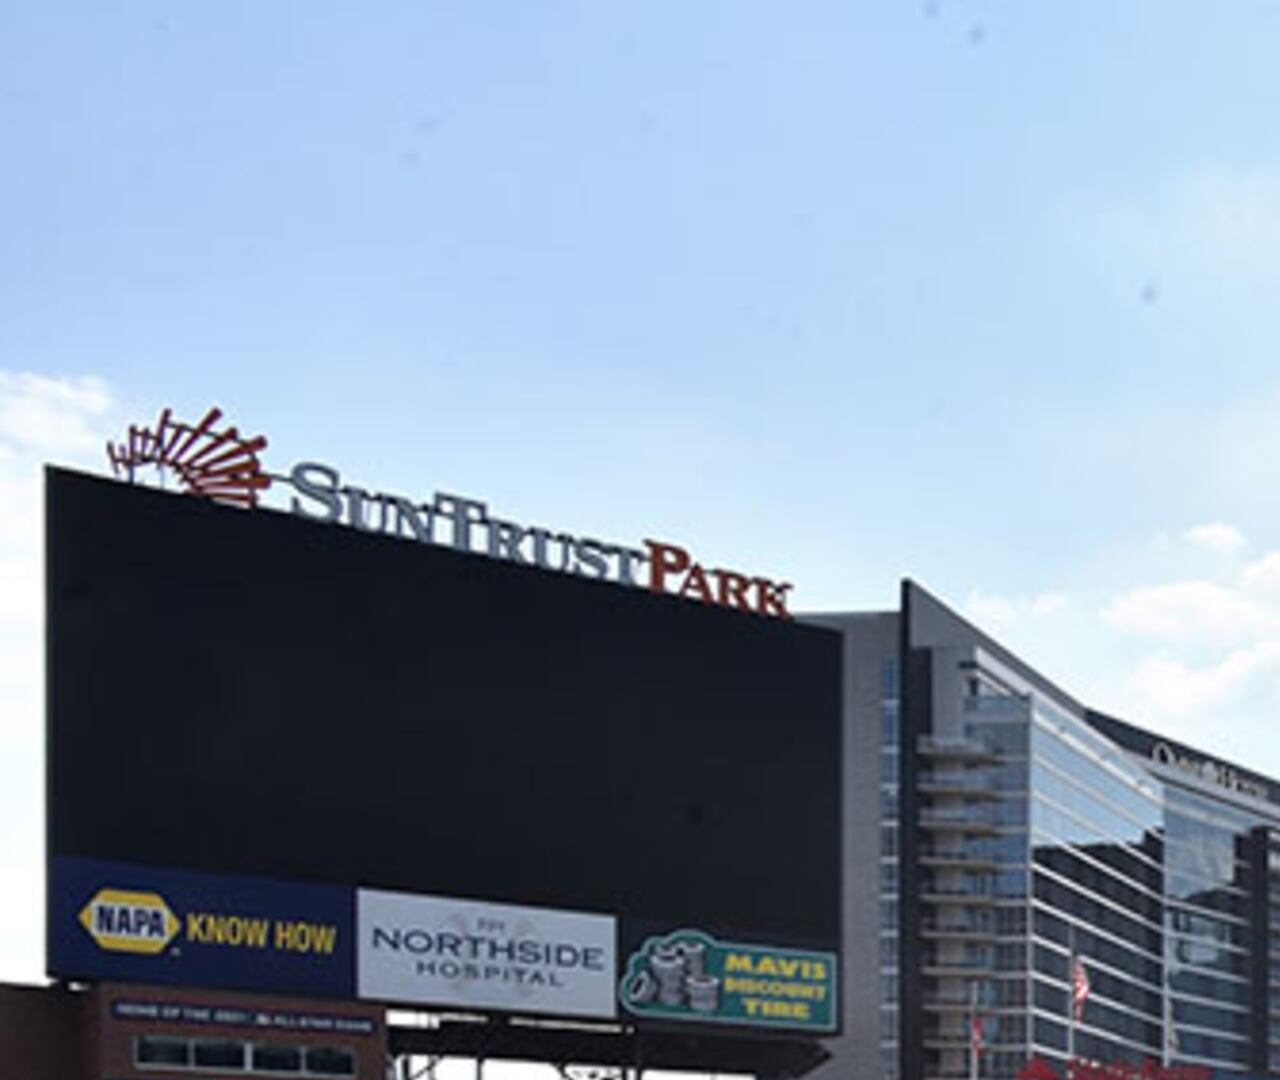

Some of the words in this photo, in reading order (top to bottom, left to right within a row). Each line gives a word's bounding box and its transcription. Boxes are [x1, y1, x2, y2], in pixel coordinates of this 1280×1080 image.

[96, 904, 165, 938] NAPA
[186, 913, 269, 947] KNOW
[274, 921, 337, 953] HOW
[372, 927, 605, 971] NORTHSIDE
[416, 960, 565, 988] HOSPITAL
[725, 954, 826, 979] MAVIS
[743, 1000, 810, 1018] TIRE
